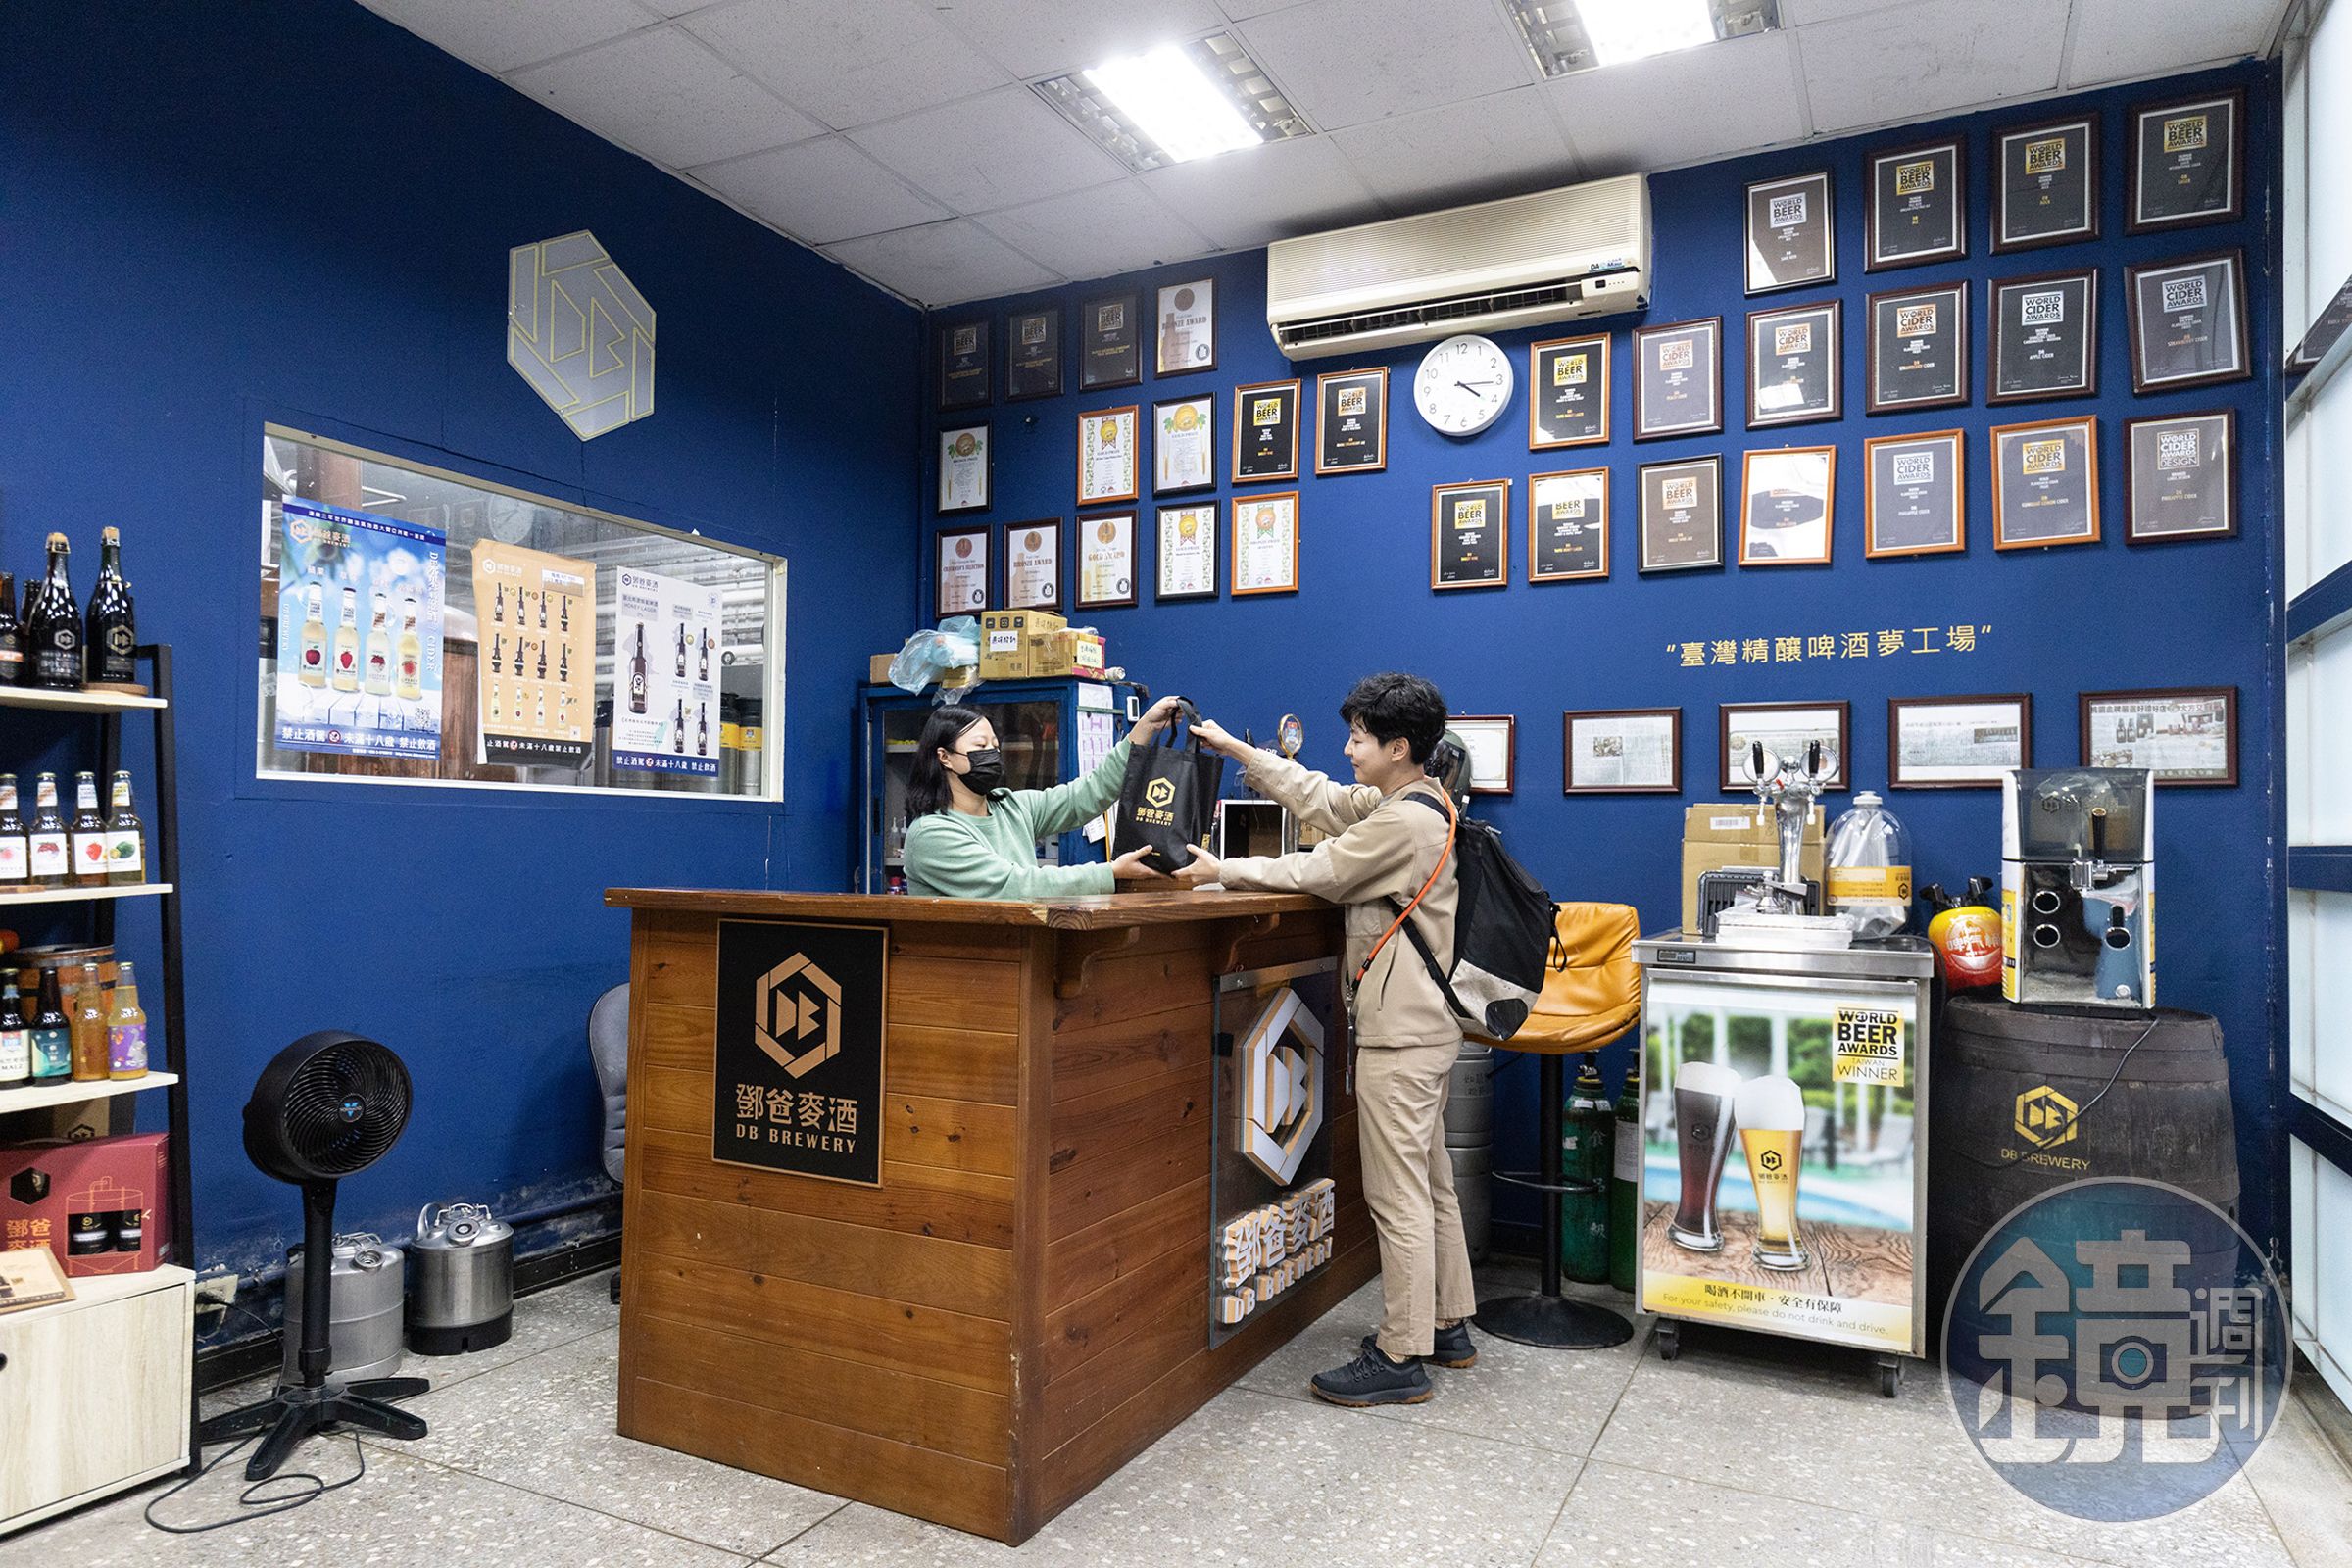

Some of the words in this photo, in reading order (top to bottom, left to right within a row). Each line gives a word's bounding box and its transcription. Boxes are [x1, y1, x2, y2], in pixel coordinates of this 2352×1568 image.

[2168, 121, 2204, 131] WORLD
[2169, 126, 2202, 141] BEER
[2168, 137, 2204, 148] AWARDS
[2030, 144, 2062, 155] WORLD
[2030, 151, 2061, 165] BEER
[1900, 166, 1931, 176] WORLD
[2030, 161, 2063, 171] AWARDS
[1900, 172, 1930, 185] BEER
[1900, 182, 1931, 191] AWARDS
[1774, 199, 1802, 209] WORLD
[1774, 205, 1801, 218] BEER
[1774, 214, 1802, 223] AWARDS
[2166, 281, 2202, 292] WORLD
[2167, 288, 2202, 301] CIDER
[2026, 296, 2060, 306] WORLD
[2167, 296, 2204, 307] AWARDS
[1901, 309, 1934, 318] WORLD
[2026, 303, 2059, 314] CIDER
[1901, 316, 1932, 326] CIDER
[2026, 312, 2061, 320] AWARDS
[1779, 328, 1808, 337] WORLD
[1779, 334, 1807, 345] CIDER
[1456, 343, 1468, 354] 12
[1478, 345, 1482, 356] 1
[1439, 352, 1449, 363] 11
[1663, 351, 1690, 361] CIDER
[1490, 357, 1497, 368] 2
[1426, 368, 1438, 379] 10
[1557, 365, 1582, 376] BEER
[1495, 373, 1503, 385] 3
[1423, 386, 1431, 397] 9
[1341, 397, 1362, 407] BEER
[1491, 394, 1498, 403] 4
[1256, 408, 1277, 417] BEER
[1429, 403, 1437, 414] 8
[1443, 415, 1450, 425] 7
[1478, 409, 1485, 420] 5
[1460, 416, 1467, 427] 6
[2161, 434, 2196, 443] WORLD
[2027, 445, 2061, 454] WORLD
[2161, 441, 2196, 452] CIDER
[2027, 451, 2060, 464] CIDER
[2161, 449, 2197, 458] AWARDS
[1897, 457, 1930, 466] WORLD
[2027, 461, 2062, 470] AWARDS
[2161, 456, 2197, 467] DESIGN
[1897, 464, 1930, 474] CIDER
[1666, 489, 1692, 500] BEER
[1555, 500, 1580, 510] BEER
[1458, 510, 1481, 519] BEER
[282, 728, 326, 743] 禁止酒駕
[344, 732, 394, 748] 未滿十八歲
[399, 737, 436, 751] 禁止飲酒
[1838, 1010, 1898, 1025] WORLD
[1838, 1023, 1898, 1045] BEER
[1838, 1042, 1898, 1056] AWARDS
[1852, 1057, 1886, 1067] TAIWAN
[1838, 1064, 1898, 1081] WINNER
[736, 1083, 858, 1135] 鄧爸麥酒
[736, 1123, 759, 1140] DB
[769, 1125, 857, 1154] BREWERY
[2001, 1148, 2018, 1160] DB
[8, 1218, 52, 1238] 鄧爸
[1222, 1178, 1335, 1289] 鄧爸麥酒
[1222, 1287, 1256, 1324] DB
[1255, 1237, 1333, 1301] BREWERY
[1663, 1293, 1679, 1303] For
[1681, 1297, 1702, 1309] your
[1704, 1298, 1735, 1314] safety,
[1738, 1303, 1770, 1318] please
[1772, 1308, 1787, 1319] do
[1788, 1312, 1806, 1323] not
[1808, 1313, 1835, 1327] drink
[1837, 1316, 1857, 1330] and
[1859, 1320, 1888, 1337] drive.
